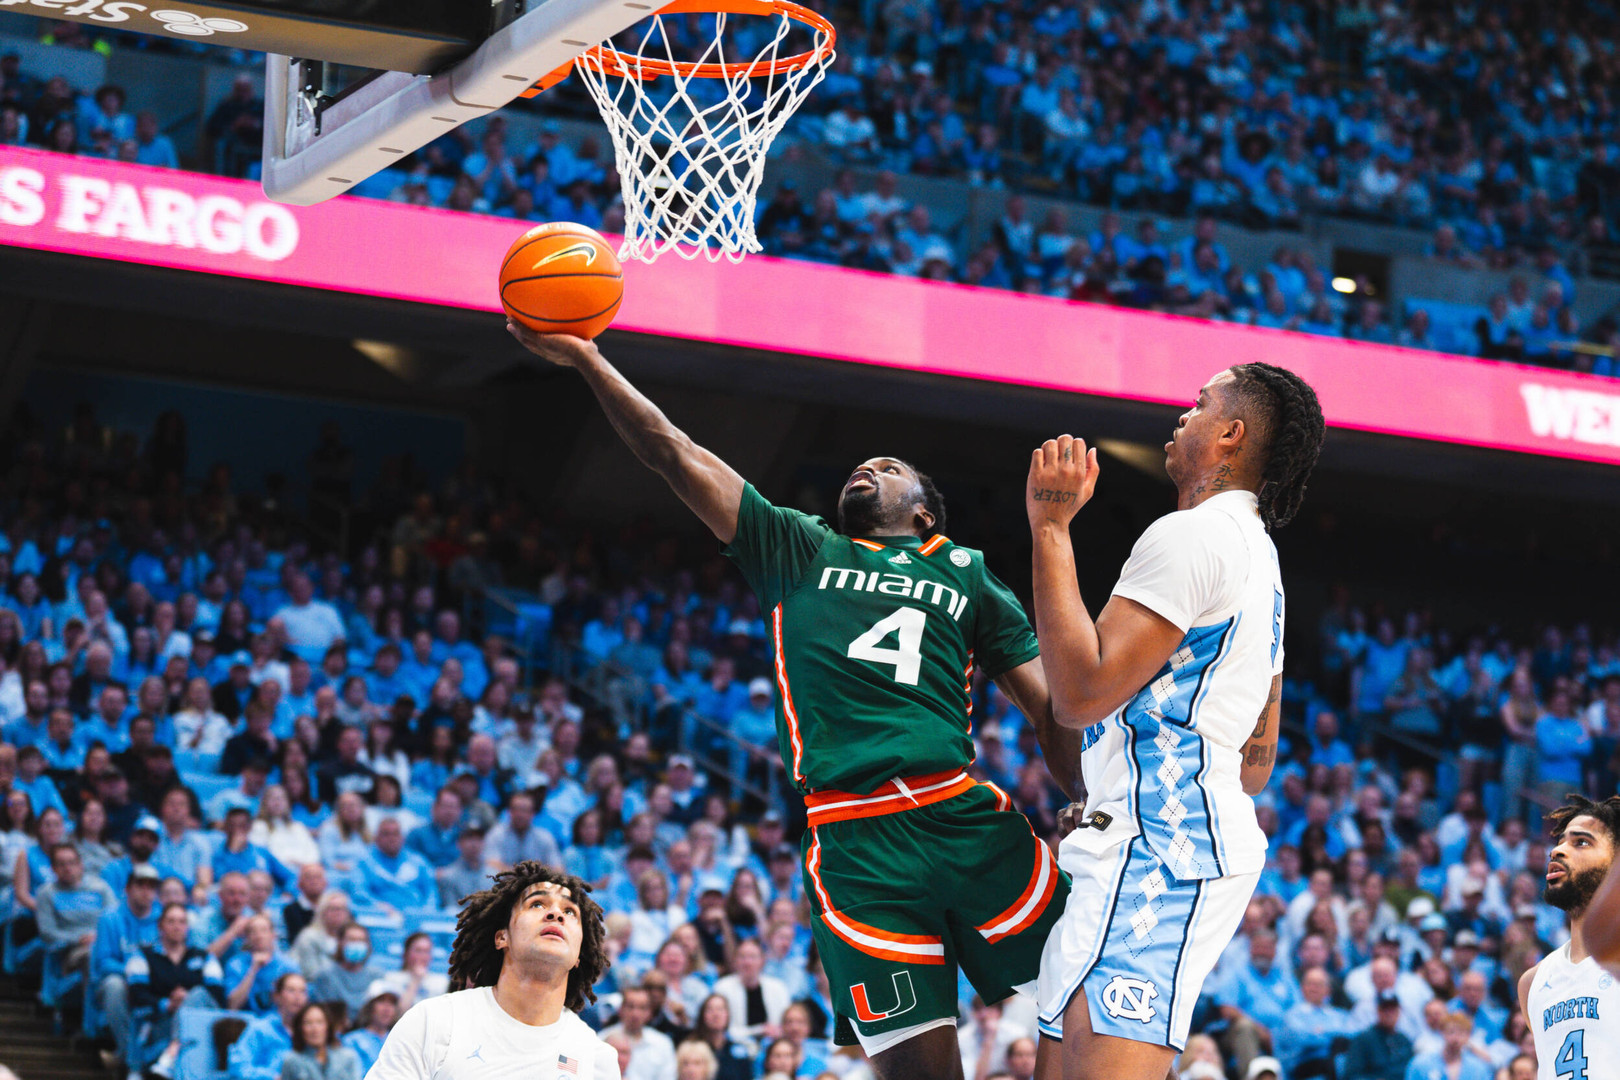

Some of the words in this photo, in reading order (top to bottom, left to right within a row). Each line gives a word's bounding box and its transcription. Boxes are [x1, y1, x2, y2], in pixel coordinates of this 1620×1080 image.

[56, 175, 299, 261] FARGO
[1032, 487, 1078, 506] LOSER
[847, 606, 927, 686] 4
[849, 970, 918, 1023] U
[1543, 996, 1600, 1032] NORTH
[1555, 1029, 1589, 1080] 4
